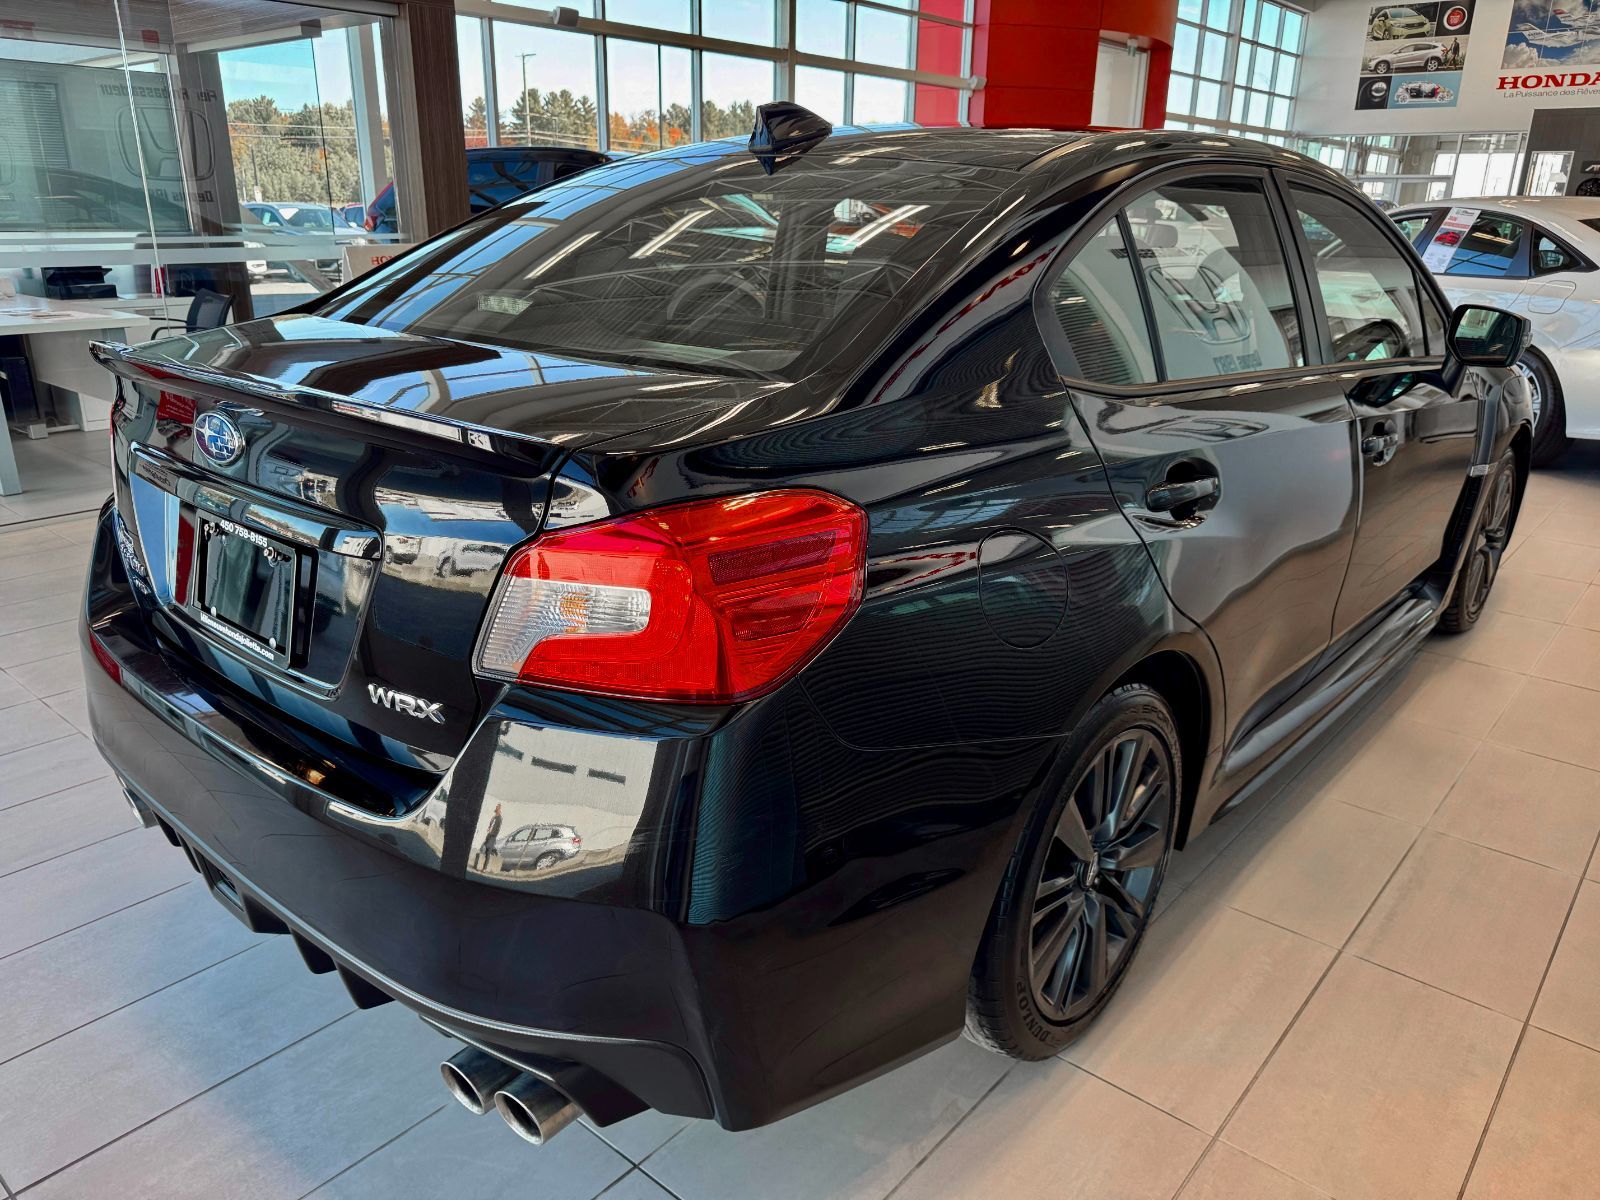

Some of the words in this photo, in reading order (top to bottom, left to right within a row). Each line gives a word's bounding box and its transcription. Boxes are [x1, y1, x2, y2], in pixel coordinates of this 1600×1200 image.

[1503, 89, 1515, 99] La
[1515, 89, 1559, 98] Puissance
[1559, 87, 1576, 96] des
[219, 519, 234, 533] 450
[234, 523, 269, 548] 759-8155
[367, 682, 446, 724] WRX
[1016, 980, 1052, 1042] DUNLOP
